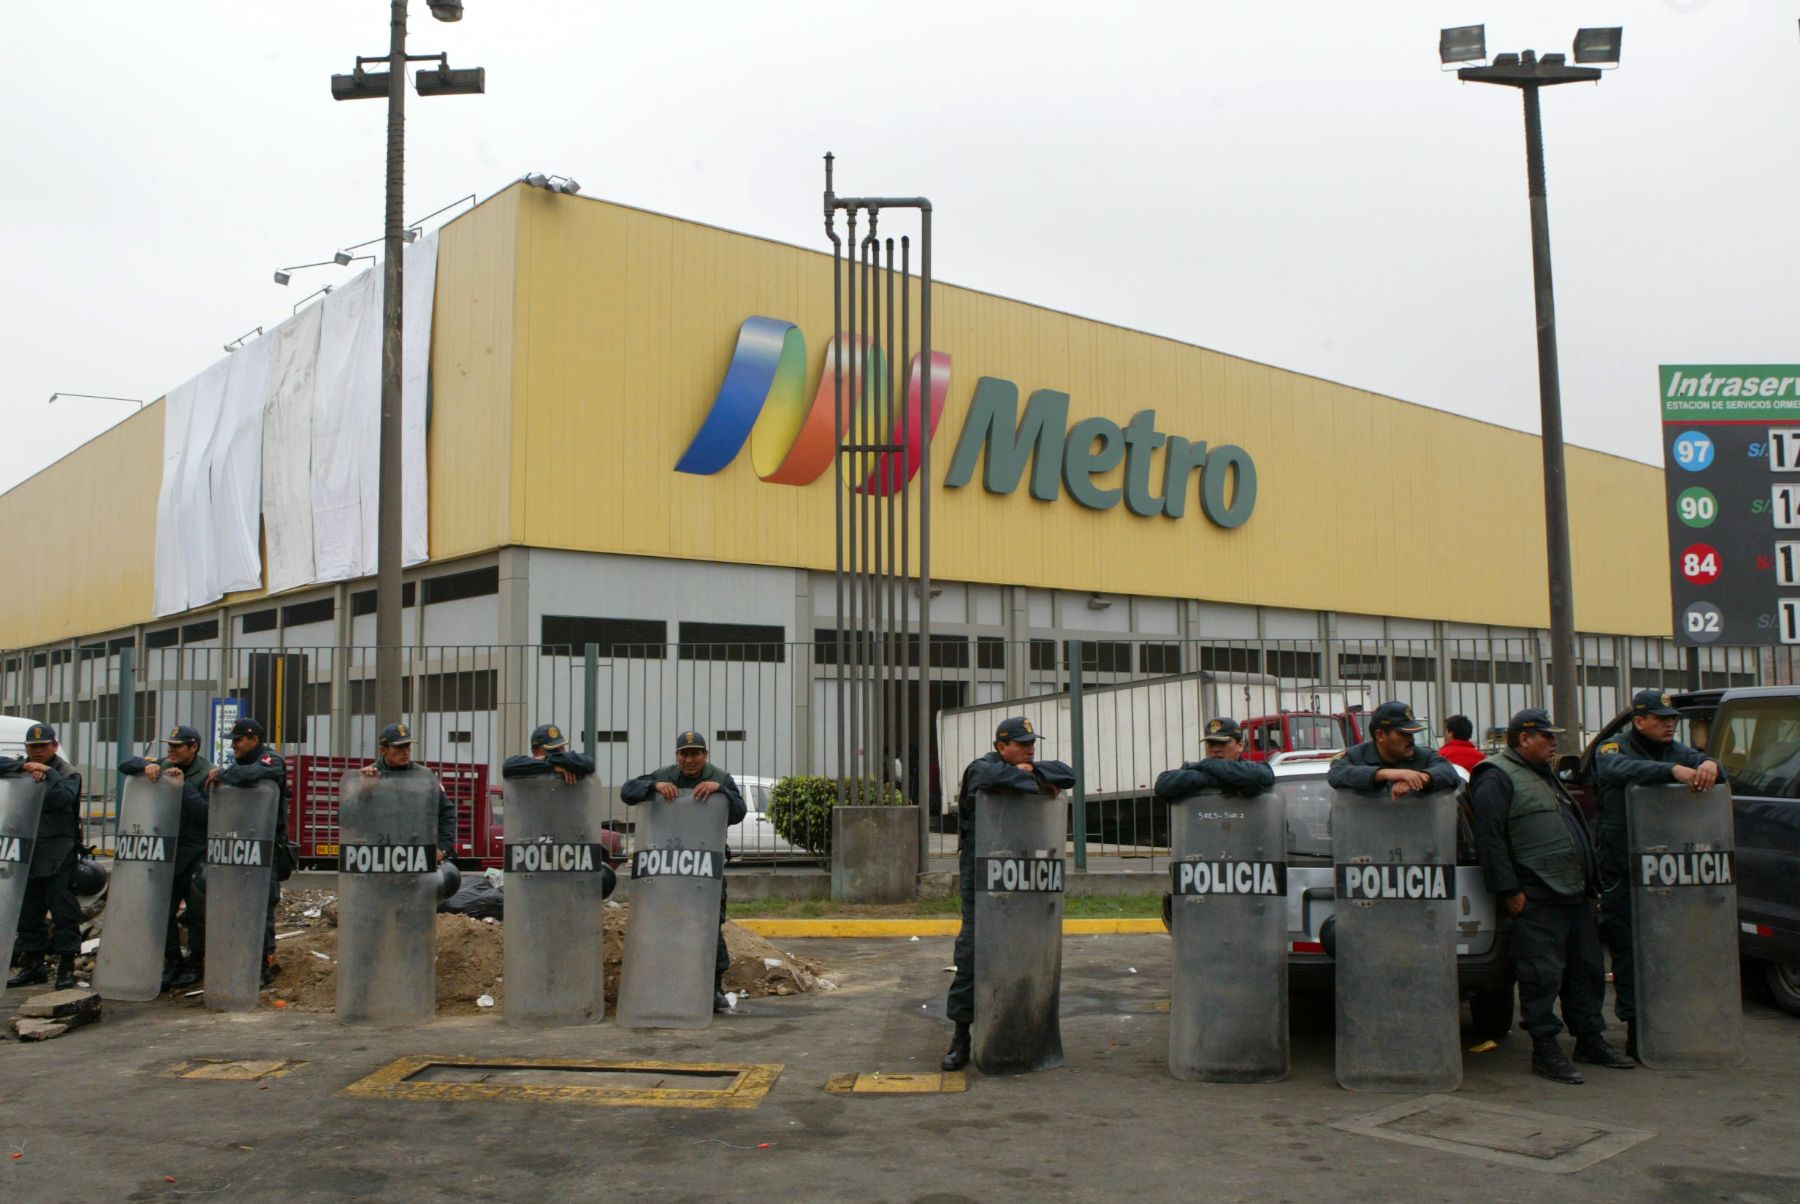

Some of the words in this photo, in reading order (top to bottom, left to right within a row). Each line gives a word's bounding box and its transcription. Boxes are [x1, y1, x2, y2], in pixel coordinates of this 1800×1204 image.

[1666, 401, 1710, 410] ESTACION
[1711, 401, 1724, 410] DE
[1725, 400, 1772, 409] SERVICIOS
[943, 376, 1257, 528] Metro
[1677, 440, 1710, 463] 97
[1681, 497, 1714, 520] 90
[1683, 553, 1717, 576] 84
[1687, 612, 1720, 632] D2
[207, 838, 262, 866] POLICIA
[345, 845, 429, 873] POLICIA
[511, 844, 594, 872] POLICIA
[637, 849, 714, 878] POLICIA
[987, 859, 1063, 891] POLICIA
[1180, 861, 1279, 895] POLICIA
[1345, 865, 1447, 899] POLICIA
[1641, 852, 1732, 886] POLICIA
